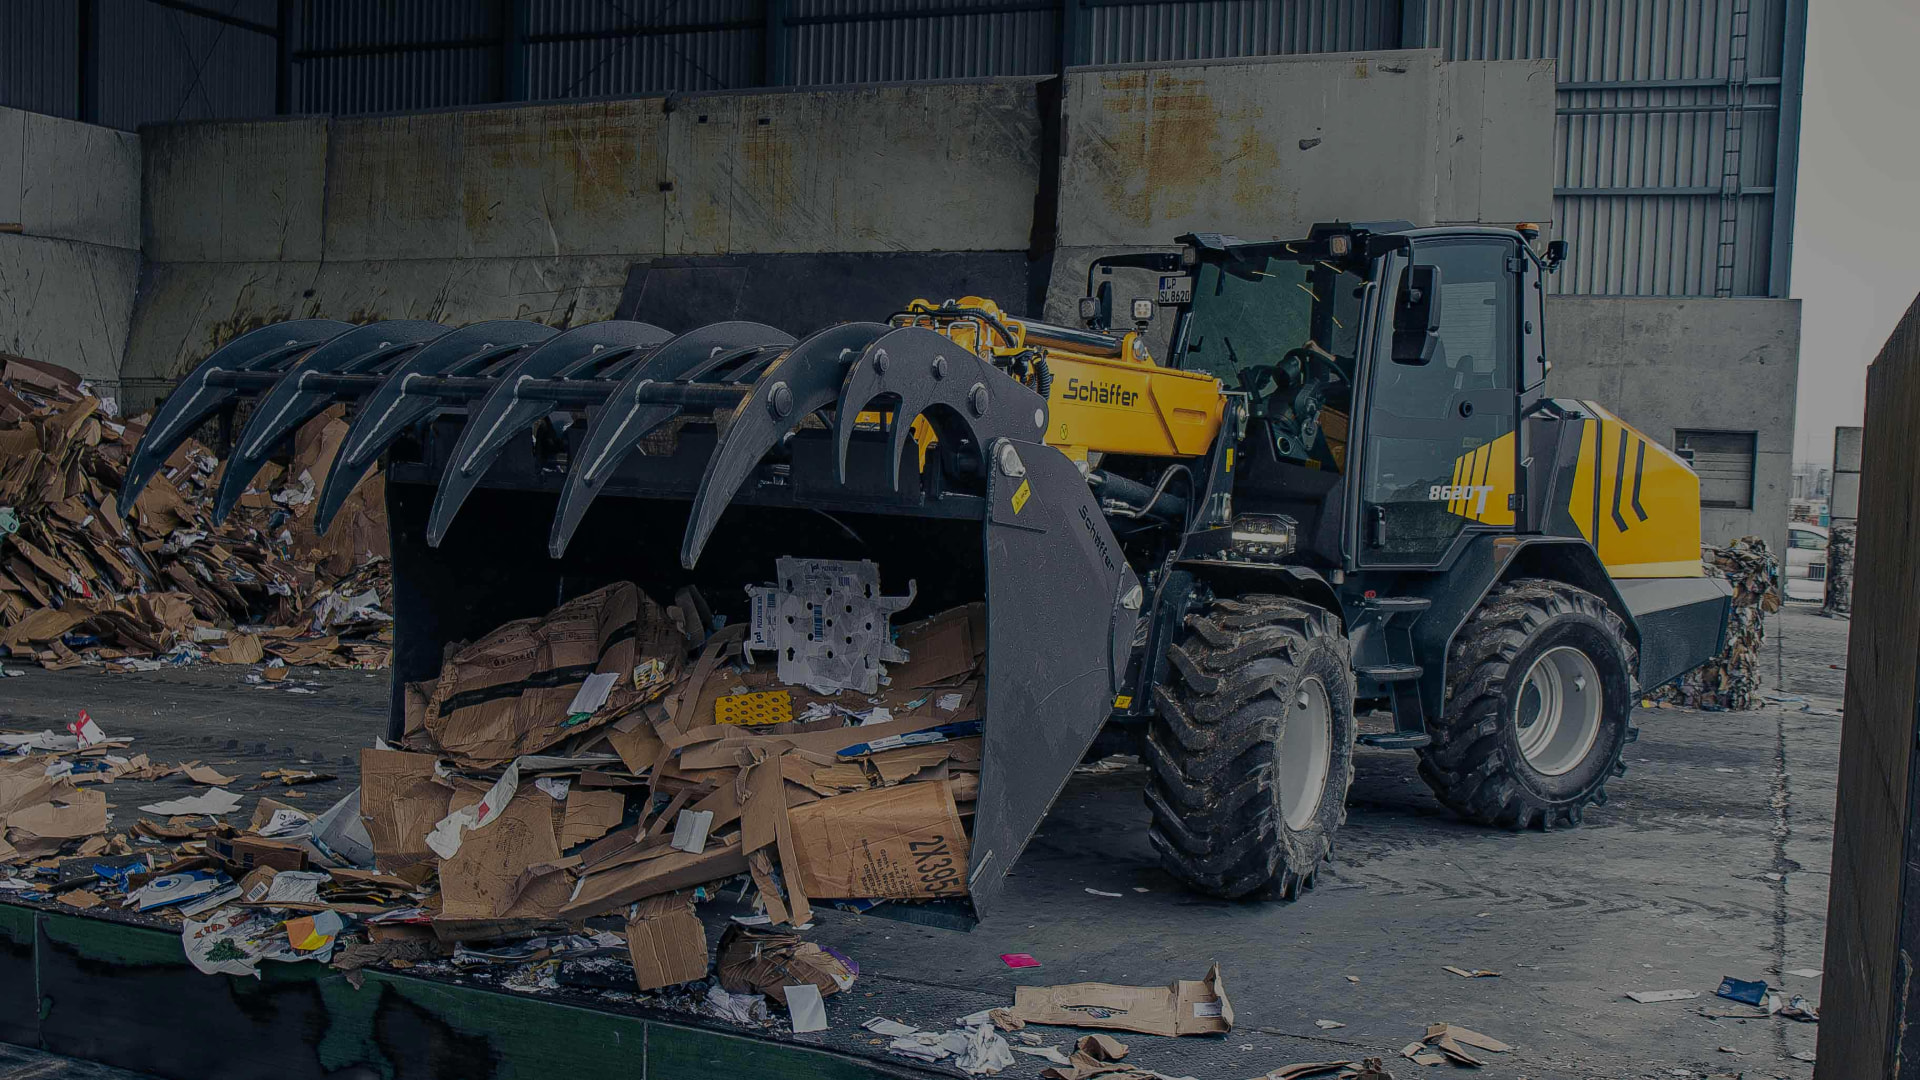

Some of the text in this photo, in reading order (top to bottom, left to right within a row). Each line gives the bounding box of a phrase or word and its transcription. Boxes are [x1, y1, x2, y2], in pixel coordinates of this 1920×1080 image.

[1166, 279, 1177, 290] LP
[1160, 290, 1190, 302] SL 8620
[1063, 378, 1139, 407] Schäffer
[1428, 485, 1494, 514] 8620T
